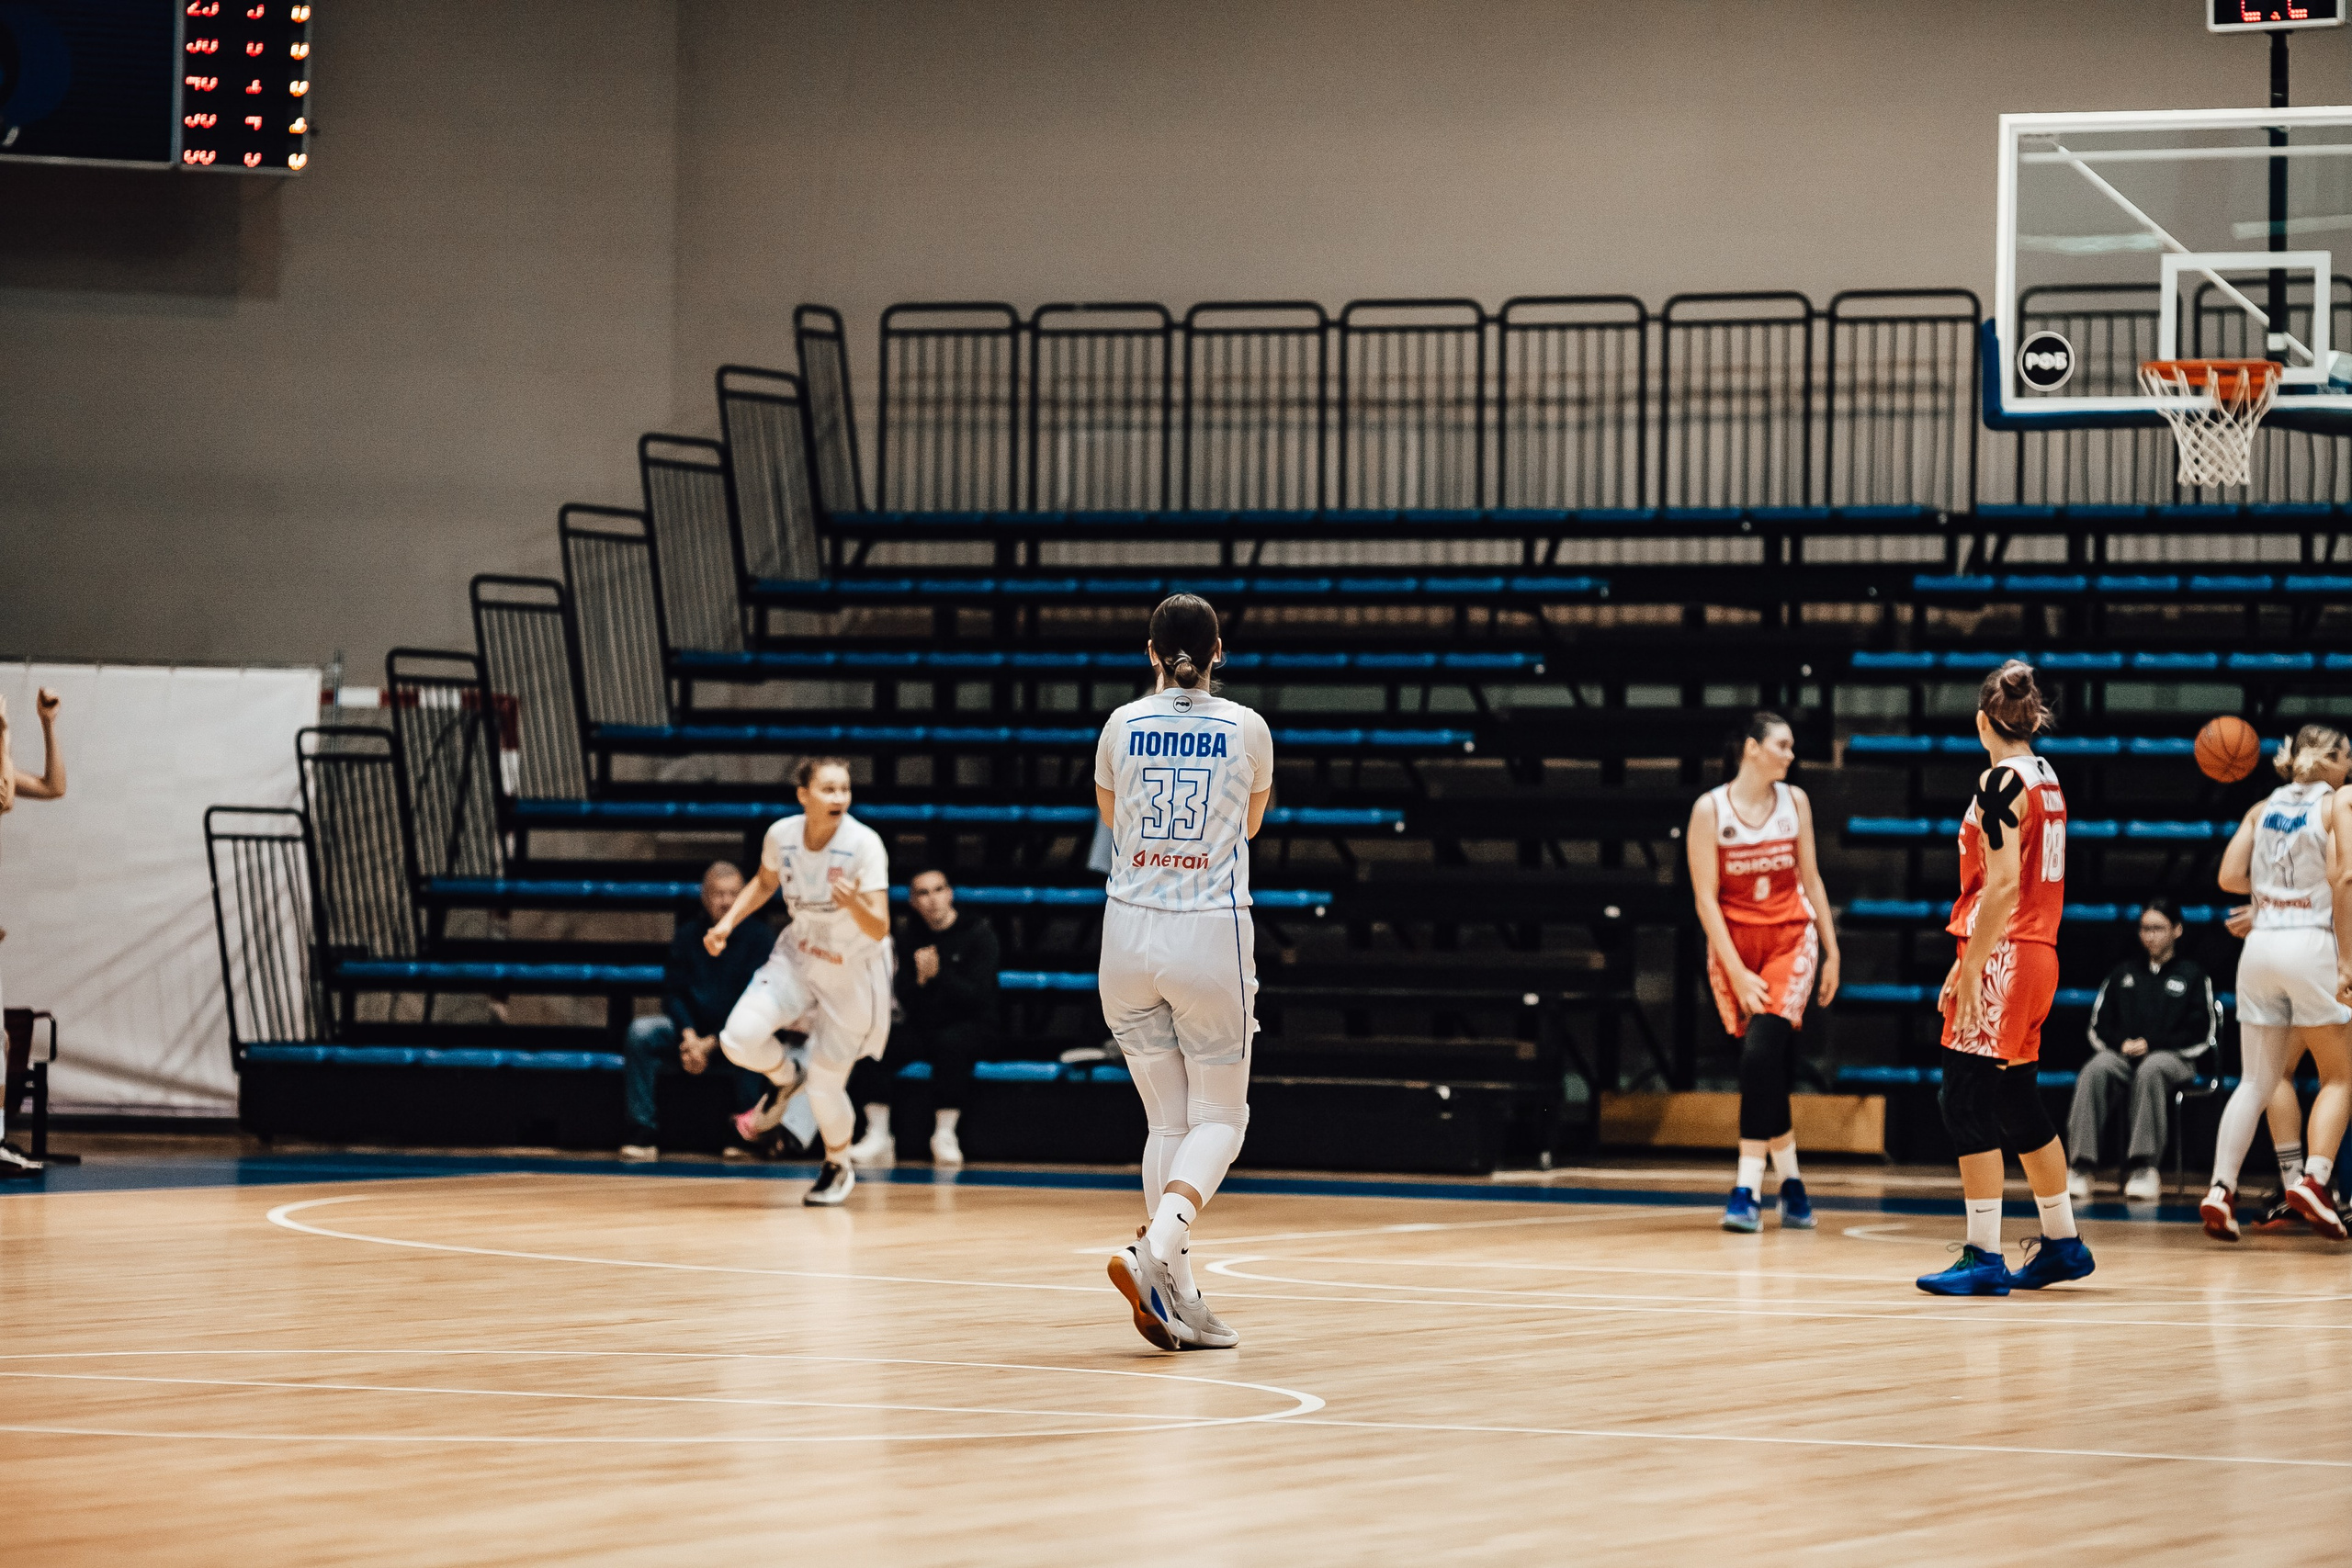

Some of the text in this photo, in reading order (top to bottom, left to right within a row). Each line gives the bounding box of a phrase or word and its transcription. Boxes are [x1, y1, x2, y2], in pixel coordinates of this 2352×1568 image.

[1129, 731, 1227, 758] ПОПОВА
[1141, 767, 1212, 841] 33
[1149, 852, 1210, 870] летай
